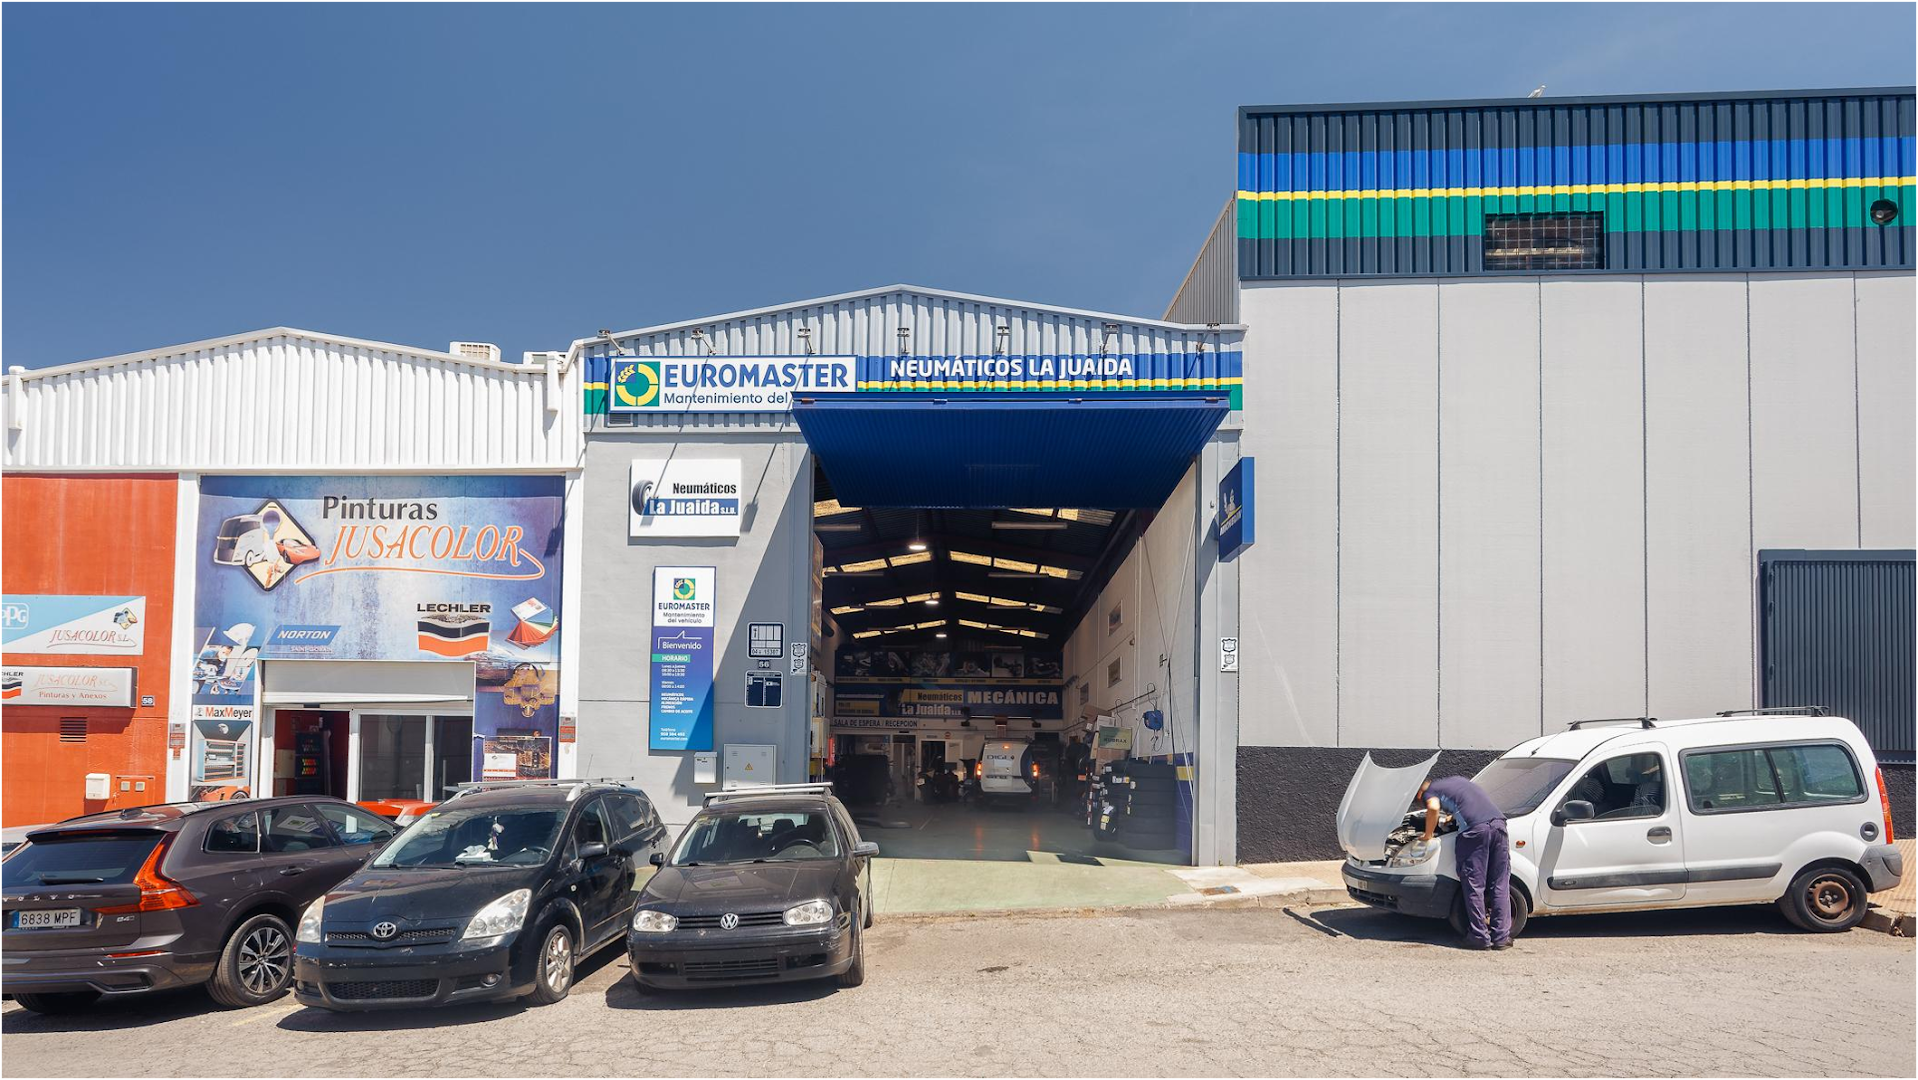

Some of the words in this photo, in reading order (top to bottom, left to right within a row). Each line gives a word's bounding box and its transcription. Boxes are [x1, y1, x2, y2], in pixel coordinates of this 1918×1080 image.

[890, 356, 1022, 378] NEUMÁTICOS
[1029, 359, 1054, 376] LA
[1059, 358, 1133, 379] JUAIDA
[664, 363, 848, 388] EUROMASTER
[664, 391, 763, 404] Mantenimiento
[767, 391, 788, 404] del
[673, 483, 736, 494] Neumáticos
[322, 495, 438, 521] Pinturas
[650, 500, 666, 514] La
[669, 500, 720, 514] Juaida
[325, 525, 524, 567] JUSACOLOR
[417, 603, 491, 613] LECHLER
[658, 602, 710, 610] EUROMASTER
[49, 630, 117, 643] JUSACOLOR
[277, 630, 331, 639] NORTON
[662, 641, 702, 649] Bienvenido
[39, 691, 70, 699] Pinturas
[79, 691, 107, 699] Anexos
[917, 692, 962, 700] Neumáticos
[968, 689, 1058, 705] MECÁNICA
[205, 706, 252, 719] MaxMeyer
[902, 704, 913, 715] La
[915, 704, 951, 715] Juaida
[21, 913, 50, 925] 6838
[54, 911, 77, 924] MPF
